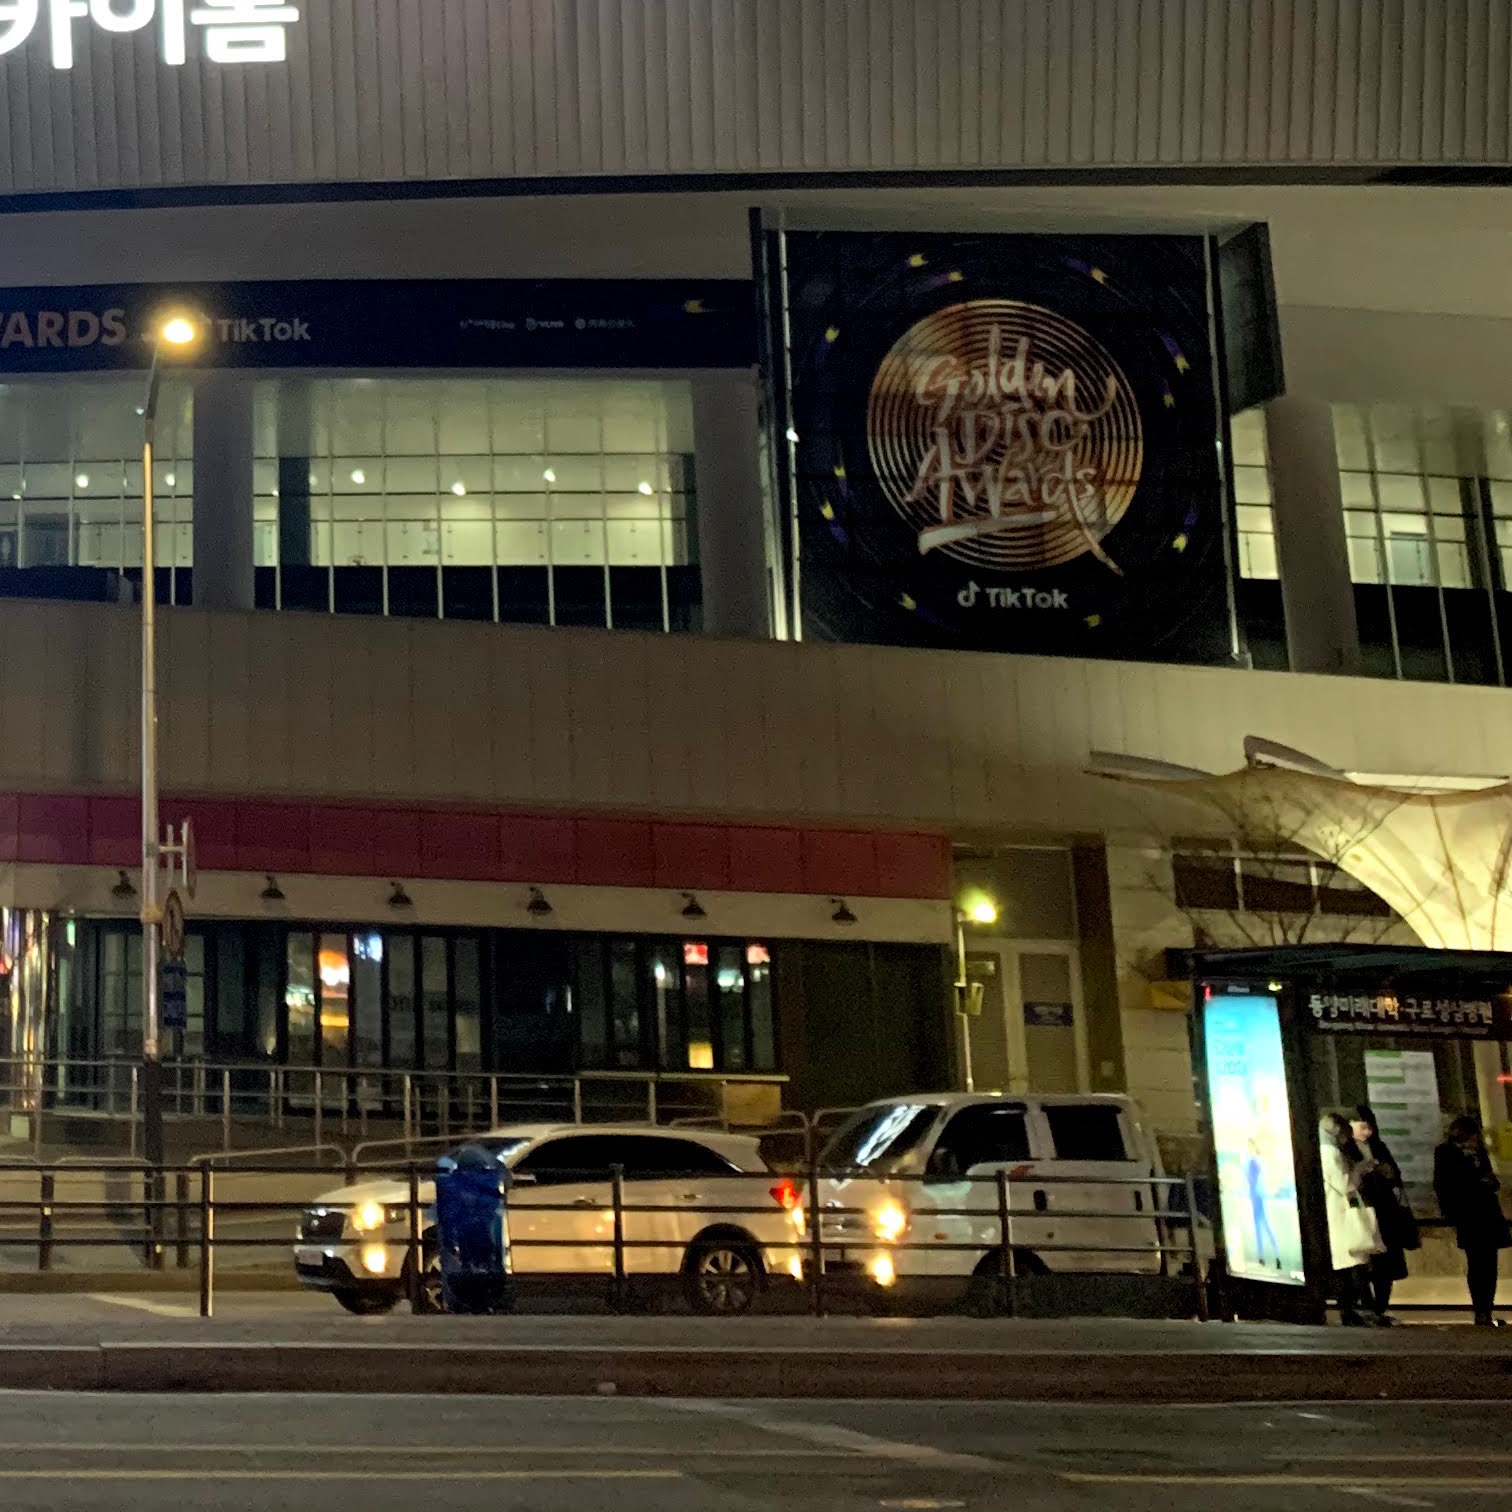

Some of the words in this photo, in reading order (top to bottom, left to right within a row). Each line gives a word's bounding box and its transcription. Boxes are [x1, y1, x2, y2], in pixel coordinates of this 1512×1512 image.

[217, 316, 312, 343] TikTok
[915, 324, 1117, 423] Golden
[984, 586, 1069, 610] TikTok
